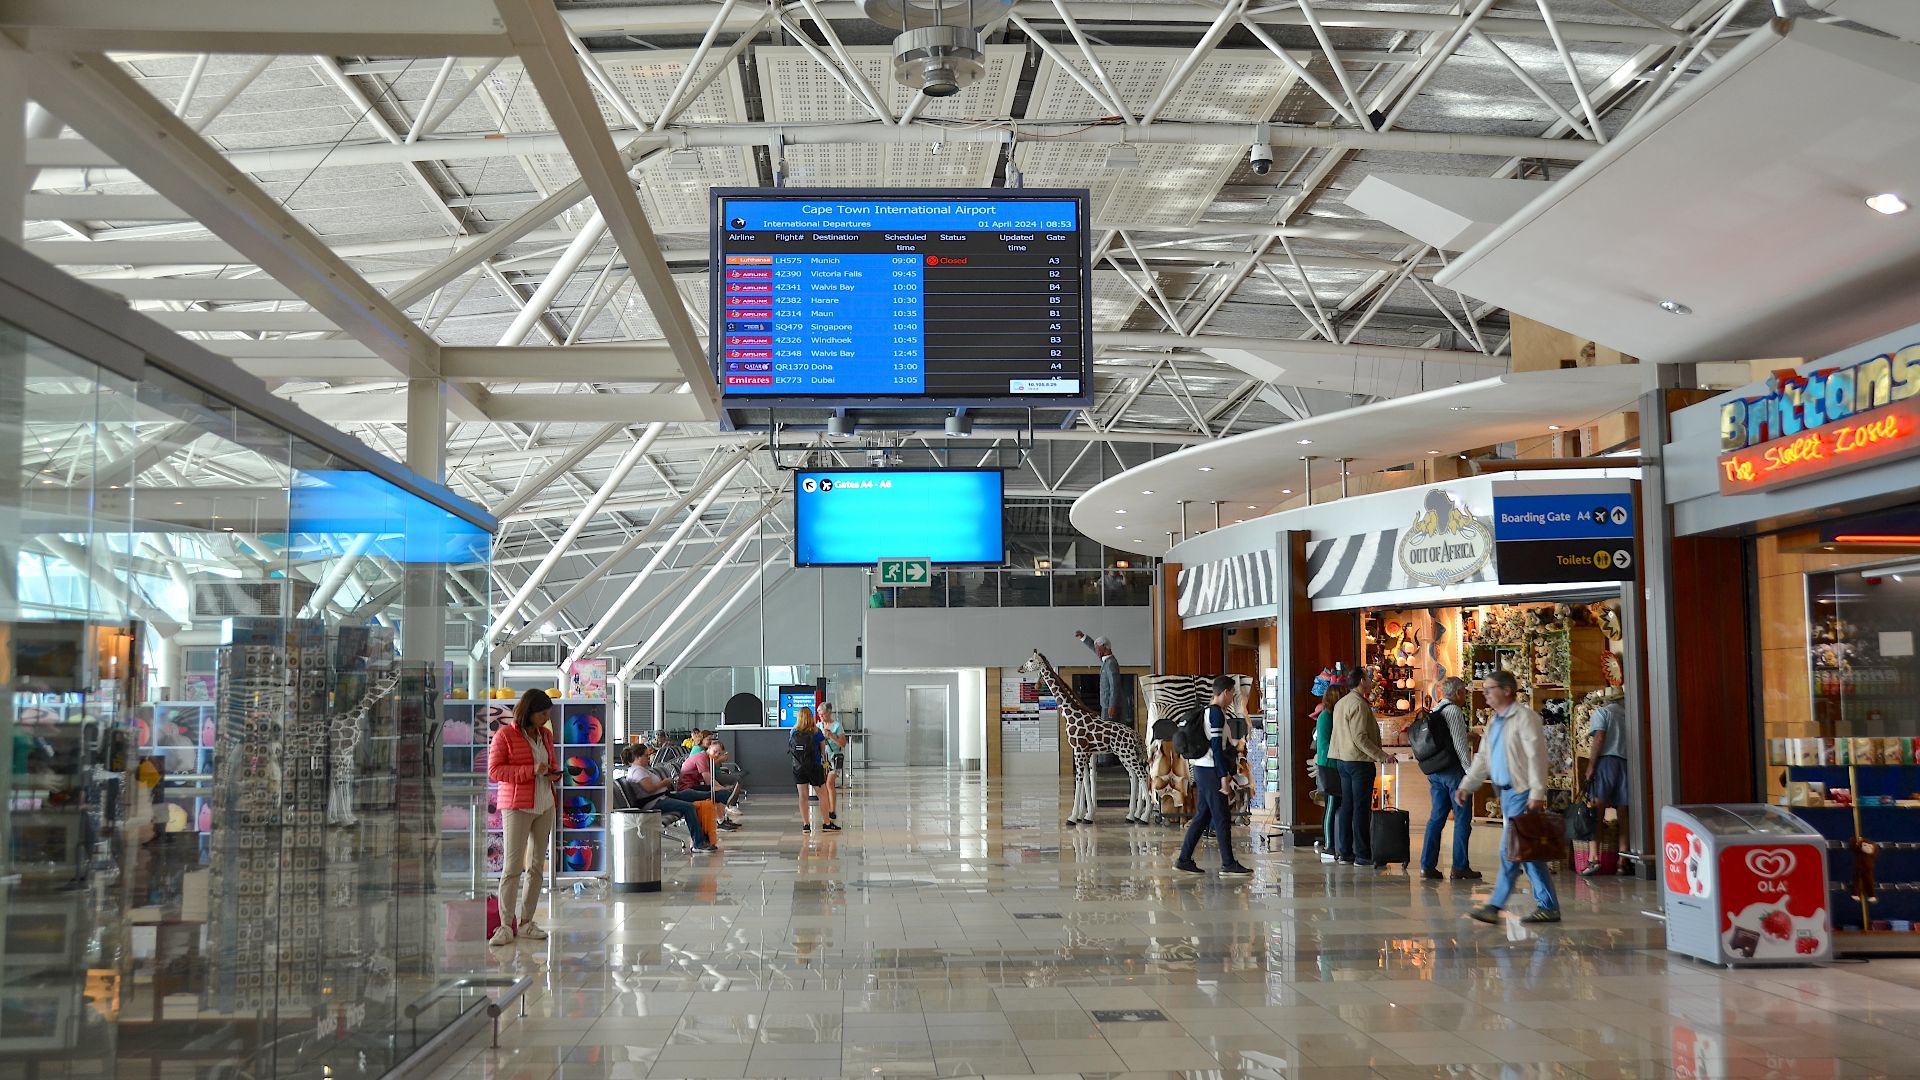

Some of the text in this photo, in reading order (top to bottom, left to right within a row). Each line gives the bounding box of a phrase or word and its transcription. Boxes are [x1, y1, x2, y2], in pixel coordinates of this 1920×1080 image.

[802, 204, 997, 216] Cape Town International Airport
[763, 220, 872, 229] International Departures
[978, 220, 990, 228] 01
[991, 220, 1012, 229] April
[1014, 220, 1037, 228] 2024
[1045, 220, 1072, 228] 08:53
[728, 233, 755, 241] Airline
[775, 233, 805, 242] Flight#
[812, 233, 859, 241] Destination
[884, 233, 927, 241] Scheduled
[940, 233, 967, 241] Status
[999, 234, 1034, 242] Updated
[939, 257, 968, 265] Closed
[1048, 257, 1060, 265] A3
[775, 270, 802, 278] 4Z390
[810, 270, 842, 278] Victoria
[843, 270, 863, 278] Falls
[892, 270, 917, 278] 09:45
[1049, 270, 1061, 278] B2
[775, 283, 801, 291] 4Z341
[810, 283, 838, 291] Walvis
[839, 283, 855, 292] Bay
[893, 283, 917, 291] 10:00
[1049, 283, 1061, 291] B4
[775, 296, 802, 304] 4Z382
[893, 296, 918, 304] 10:30
[1049, 296, 1061, 304] B5
[775, 310, 802, 318] 4Z314
[775, 323, 804, 332] SQ479
[811, 323, 853, 332] Singapore
[893, 323, 918, 331] 10:40
[775, 336, 802, 344] 4Z326
[810, 336, 852, 344] Windhoek
[893, 336, 918, 344] 10:45
[1050, 336, 1062, 344] B3
[839, 350, 856, 358] Bay
[893, 349, 918, 357] 12:45
[1050, 349, 1062, 357] B2
[775, 363, 810, 372] QR1370
[811, 363, 833, 371] Doha
[1050, 362, 1062, 370] A4
[775, 376, 802, 384] EK773
[811, 376, 835, 384] Dubai
[893, 376, 918, 384] 13:05
[1720, 343, 1920, 453] Brittans
[1721, 415, 1898, 481] The Sweet Zone
[834, 480, 859, 489] Gates
[861, 480, 873, 488] A4
[1501, 511, 1591, 524] Boarding Gate A4
[1409, 540, 1476, 565] OUT OF AFRICA
[1557, 555, 1592, 566] Toilets
[1669, 864, 1680, 873] OLA
[1757, 881, 1787, 892] OLA
